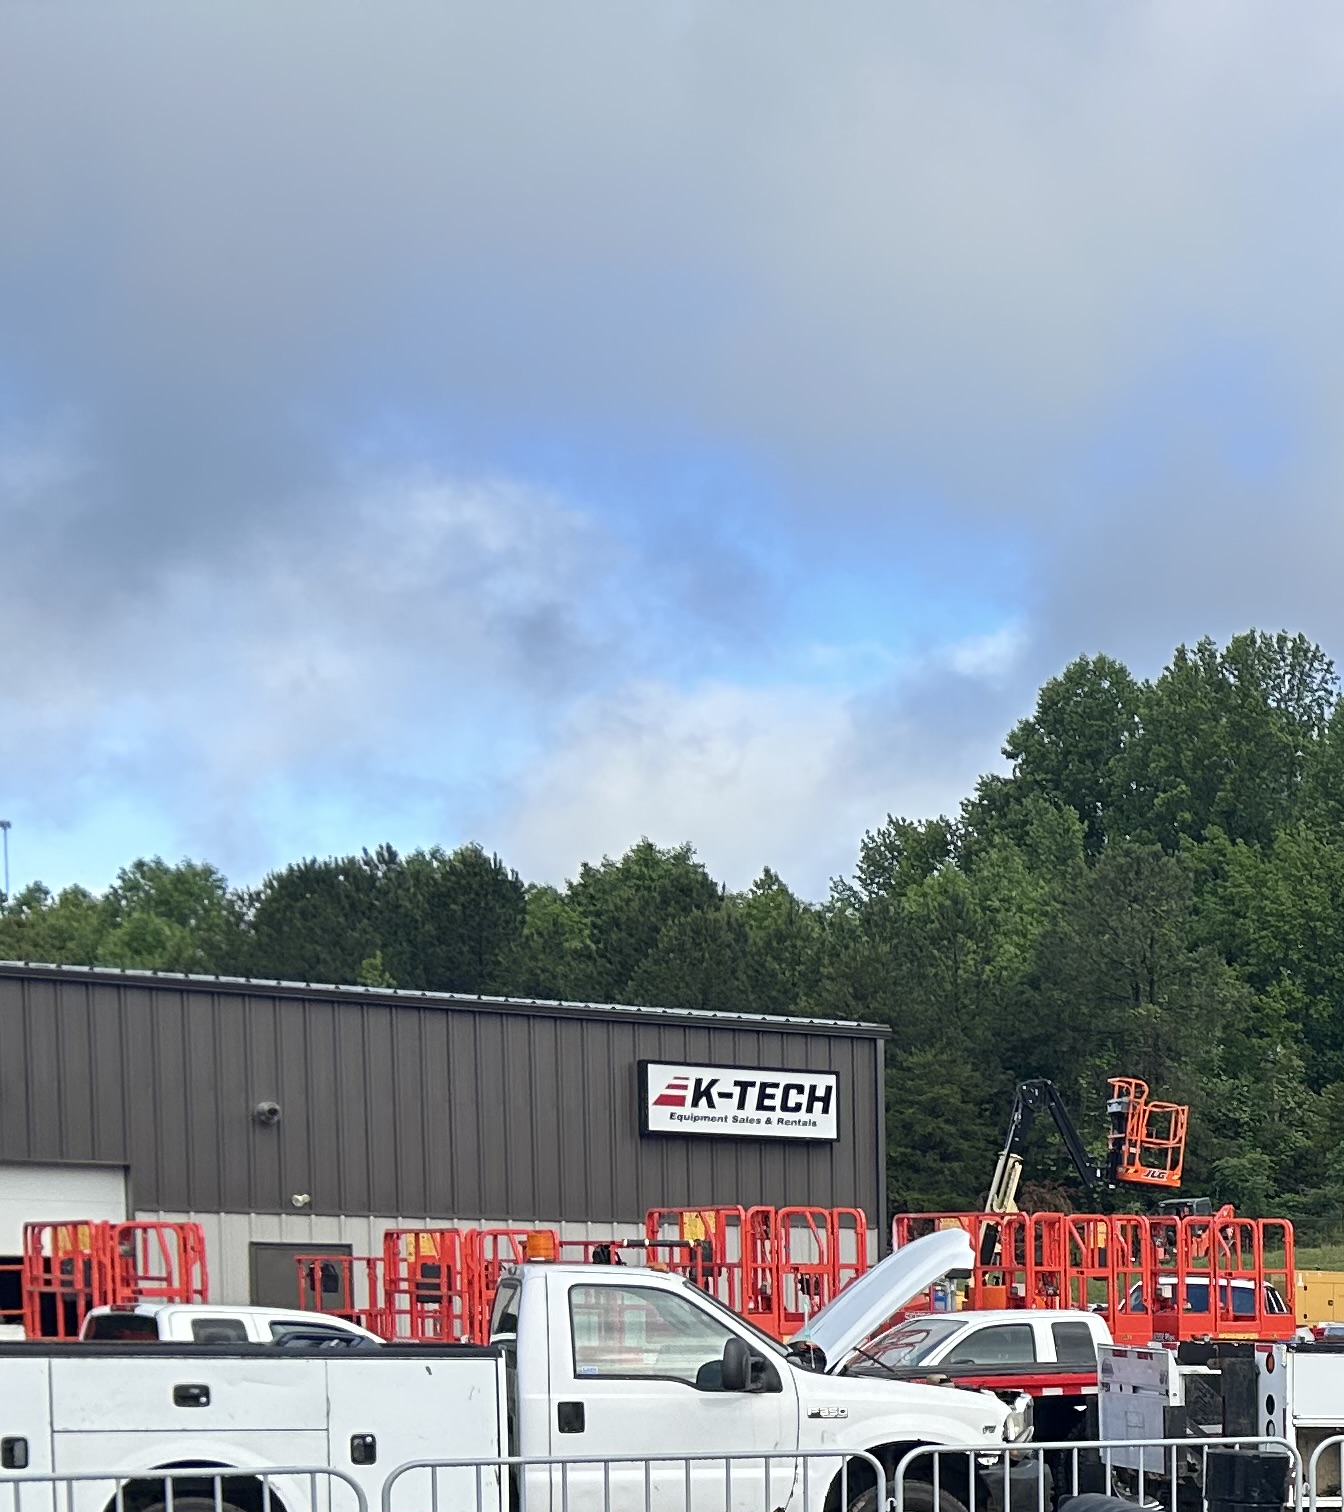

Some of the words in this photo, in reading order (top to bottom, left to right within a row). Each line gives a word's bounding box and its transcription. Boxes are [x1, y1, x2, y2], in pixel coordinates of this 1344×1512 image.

[691, 1078, 833, 1115] K-TECH
[669, 1112, 728, 1124] Equipment
[732, 1115, 761, 1125] Sales
[765, 1117, 772, 1125] &
[777, 1117, 817, 1127] Rentals
